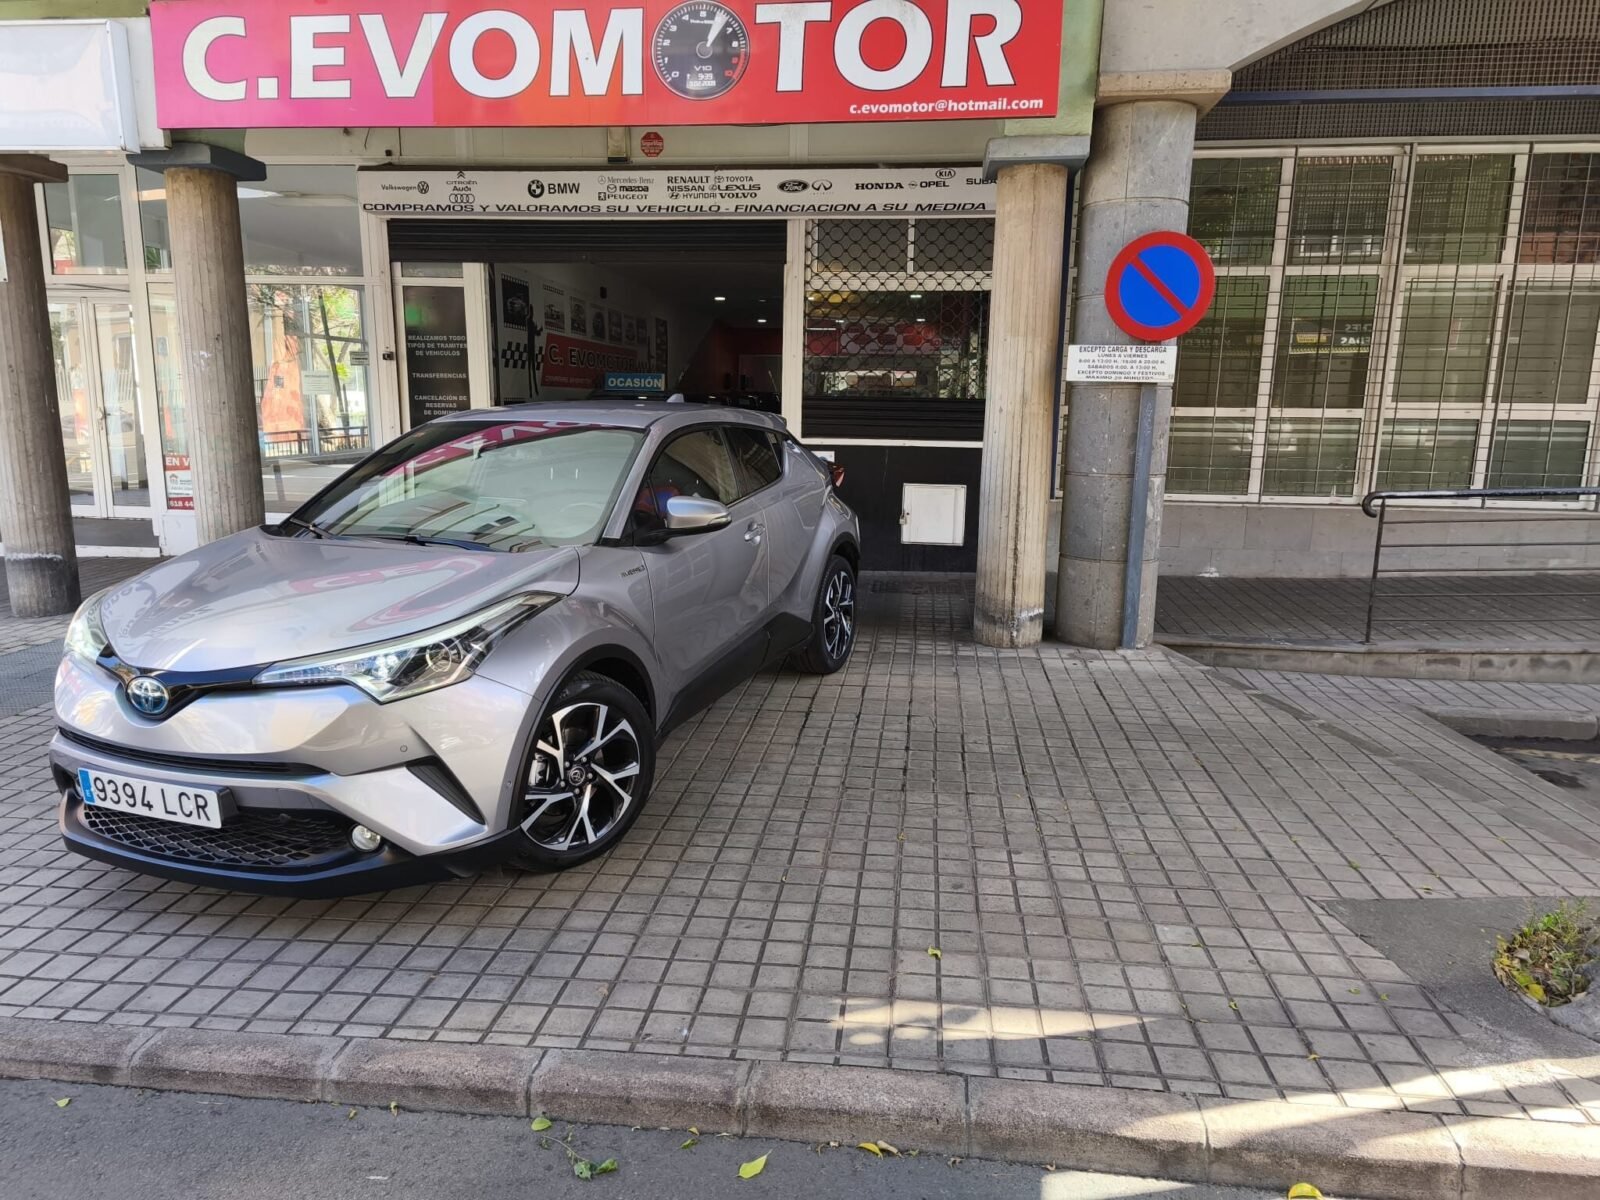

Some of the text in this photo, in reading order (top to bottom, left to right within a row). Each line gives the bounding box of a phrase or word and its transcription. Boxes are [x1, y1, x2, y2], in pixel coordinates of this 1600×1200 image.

[850, 98, 1044, 114] c.evomotor@hotmail.com
[667, 176, 711, 184] RENAULT
[548, 183, 580, 194] BMW
[855, 182, 904, 190] HONDA
[363, 203, 475, 212] COMPRAMOS
[480, 204, 490, 212] Y
[496, 204, 601, 212] VALORAMOS
[606, 204, 629, 212] SU
[636, 204, 720, 213] VEHICULO
[734, 203, 861, 213] FINANCIACION
[865, 203, 877, 211] A
[882, 203, 908, 211] SU
[915, 202, 986, 211] MEDIDA
[608, 376, 662, 388] OCASIÓN
[165, 456, 180, 466] EN
[93, 777, 211, 822] 9394 LCR
